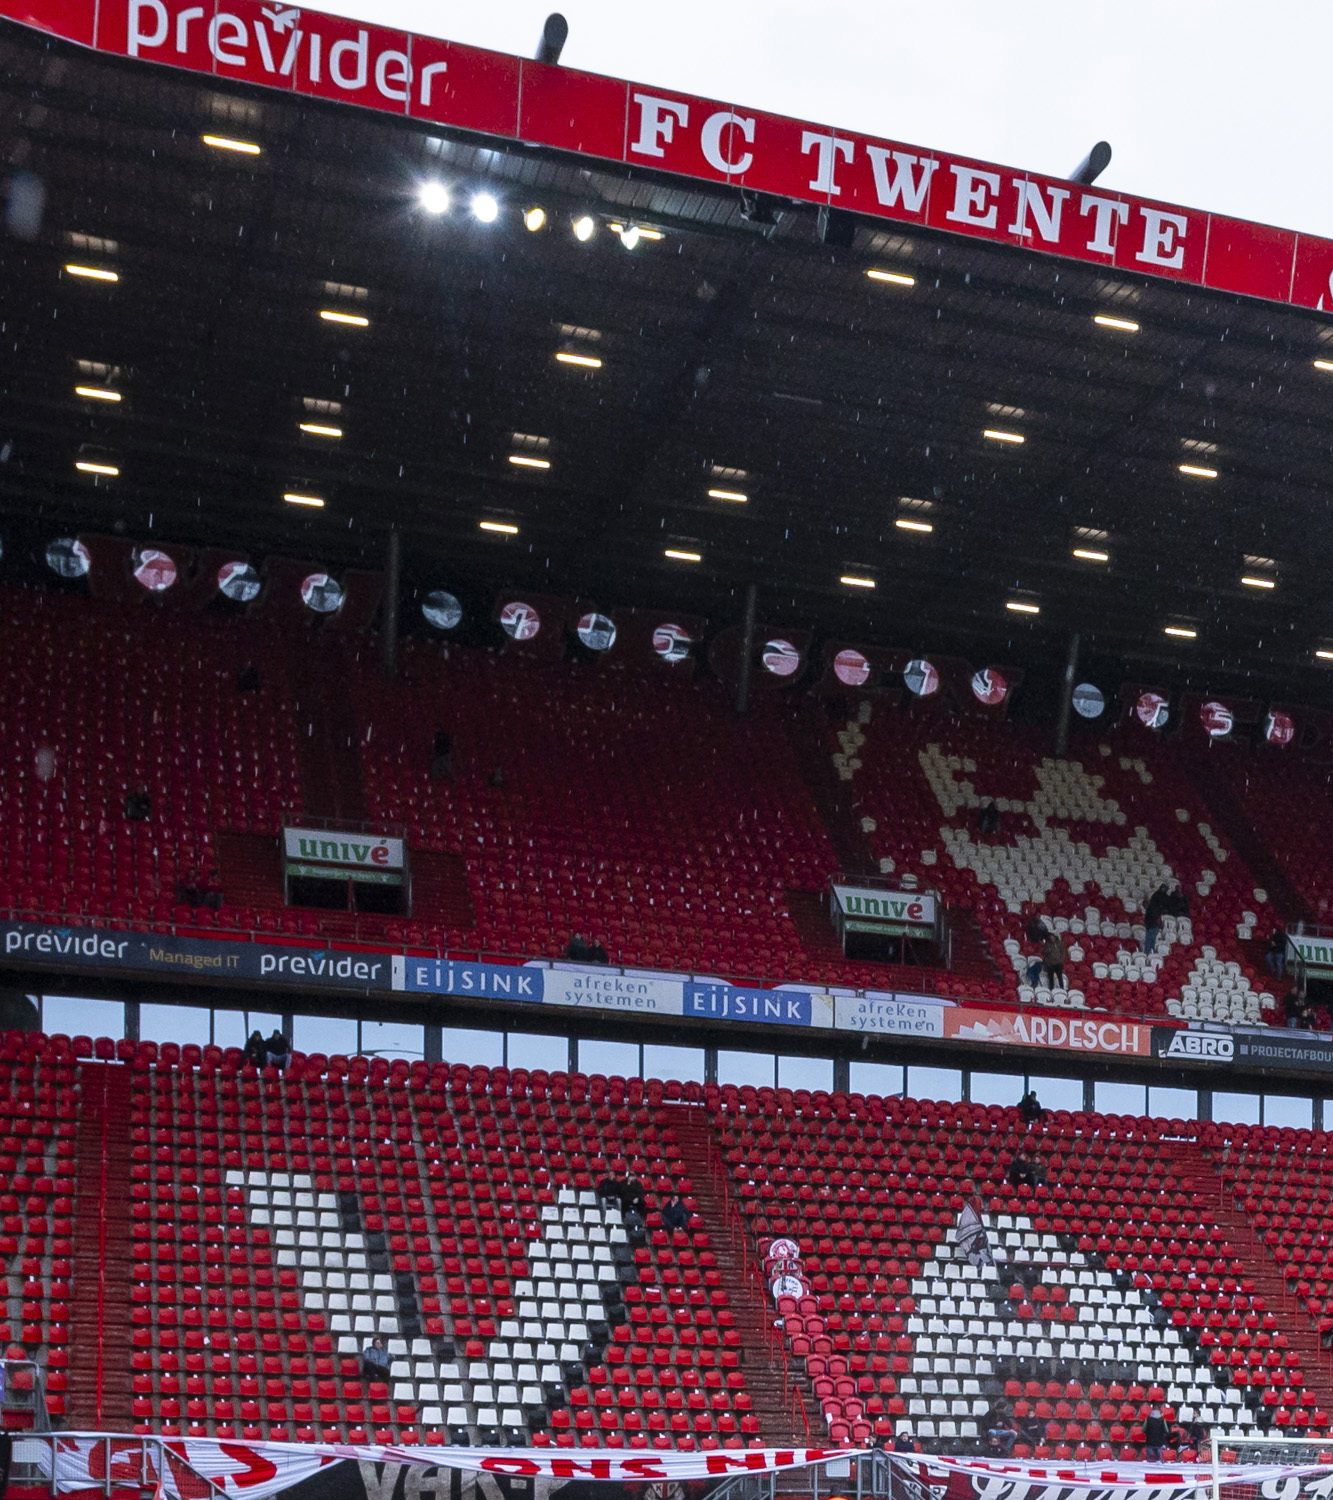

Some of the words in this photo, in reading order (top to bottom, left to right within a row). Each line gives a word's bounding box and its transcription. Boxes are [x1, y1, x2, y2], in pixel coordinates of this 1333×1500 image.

[127, 0, 448, 105] previder
[631, 93, 756, 175] FC
[801, 130, 1188, 271] TWENTE
[298, 838, 390, 865] univé
[845, 896, 923, 920] univé
[5, 926, 129, 961] previder
[260, 949, 382, 982] previder
[1010, 1013, 1139, 1052] ARDESCH
[1168, 1035, 1234, 1057] ABRO
